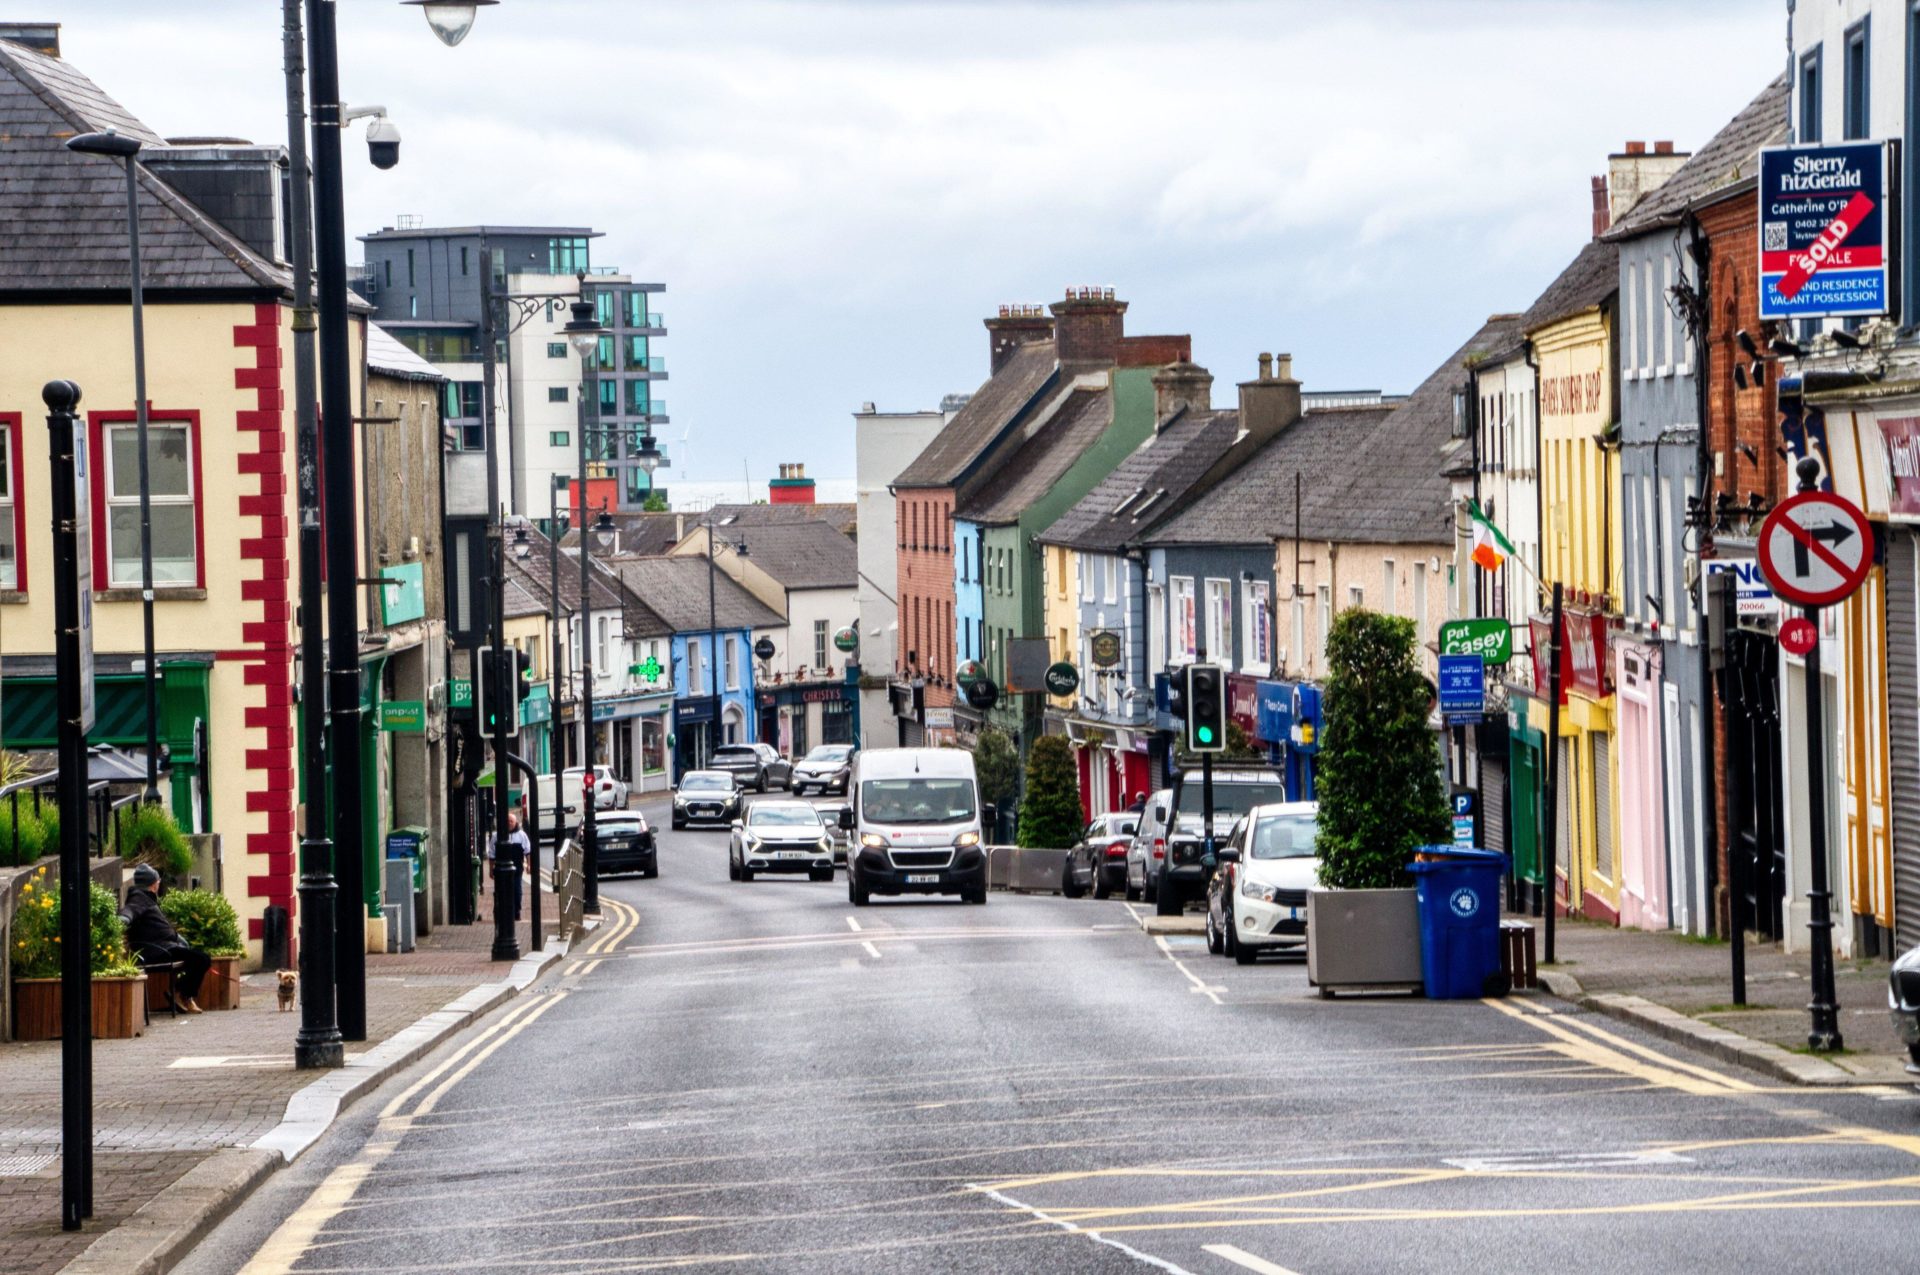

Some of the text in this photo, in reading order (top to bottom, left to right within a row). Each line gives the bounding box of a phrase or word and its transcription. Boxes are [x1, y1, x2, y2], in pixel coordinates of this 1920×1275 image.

[1793, 156, 1847, 174] Sherry
[1781, 169, 1862, 192] FitzGerald
[1771, 198, 1825, 215] Catherine
[1795, 220, 1817, 229] 0402
[1799, 221, 1849, 275] SOLD
[1826, 251, 1852, 265] ALE
[1822, 278, 1879, 291] RESIDENCE
[1813, 291, 1877, 304] POSSESSION
[1561, 374, 1583, 415] SOUVENIR
[1585, 369, 1600, 414] SHOP
[1739, 603, 1766, 611] 20066
[1446, 625, 1470, 642] Pat
[1445, 629, 1506, 656] Casey
[1048, 672, 1076, 687] Carlsberg
[803, 689, 840, 703] CHRISTY'S
[1457, 796, 1467, 813] P
